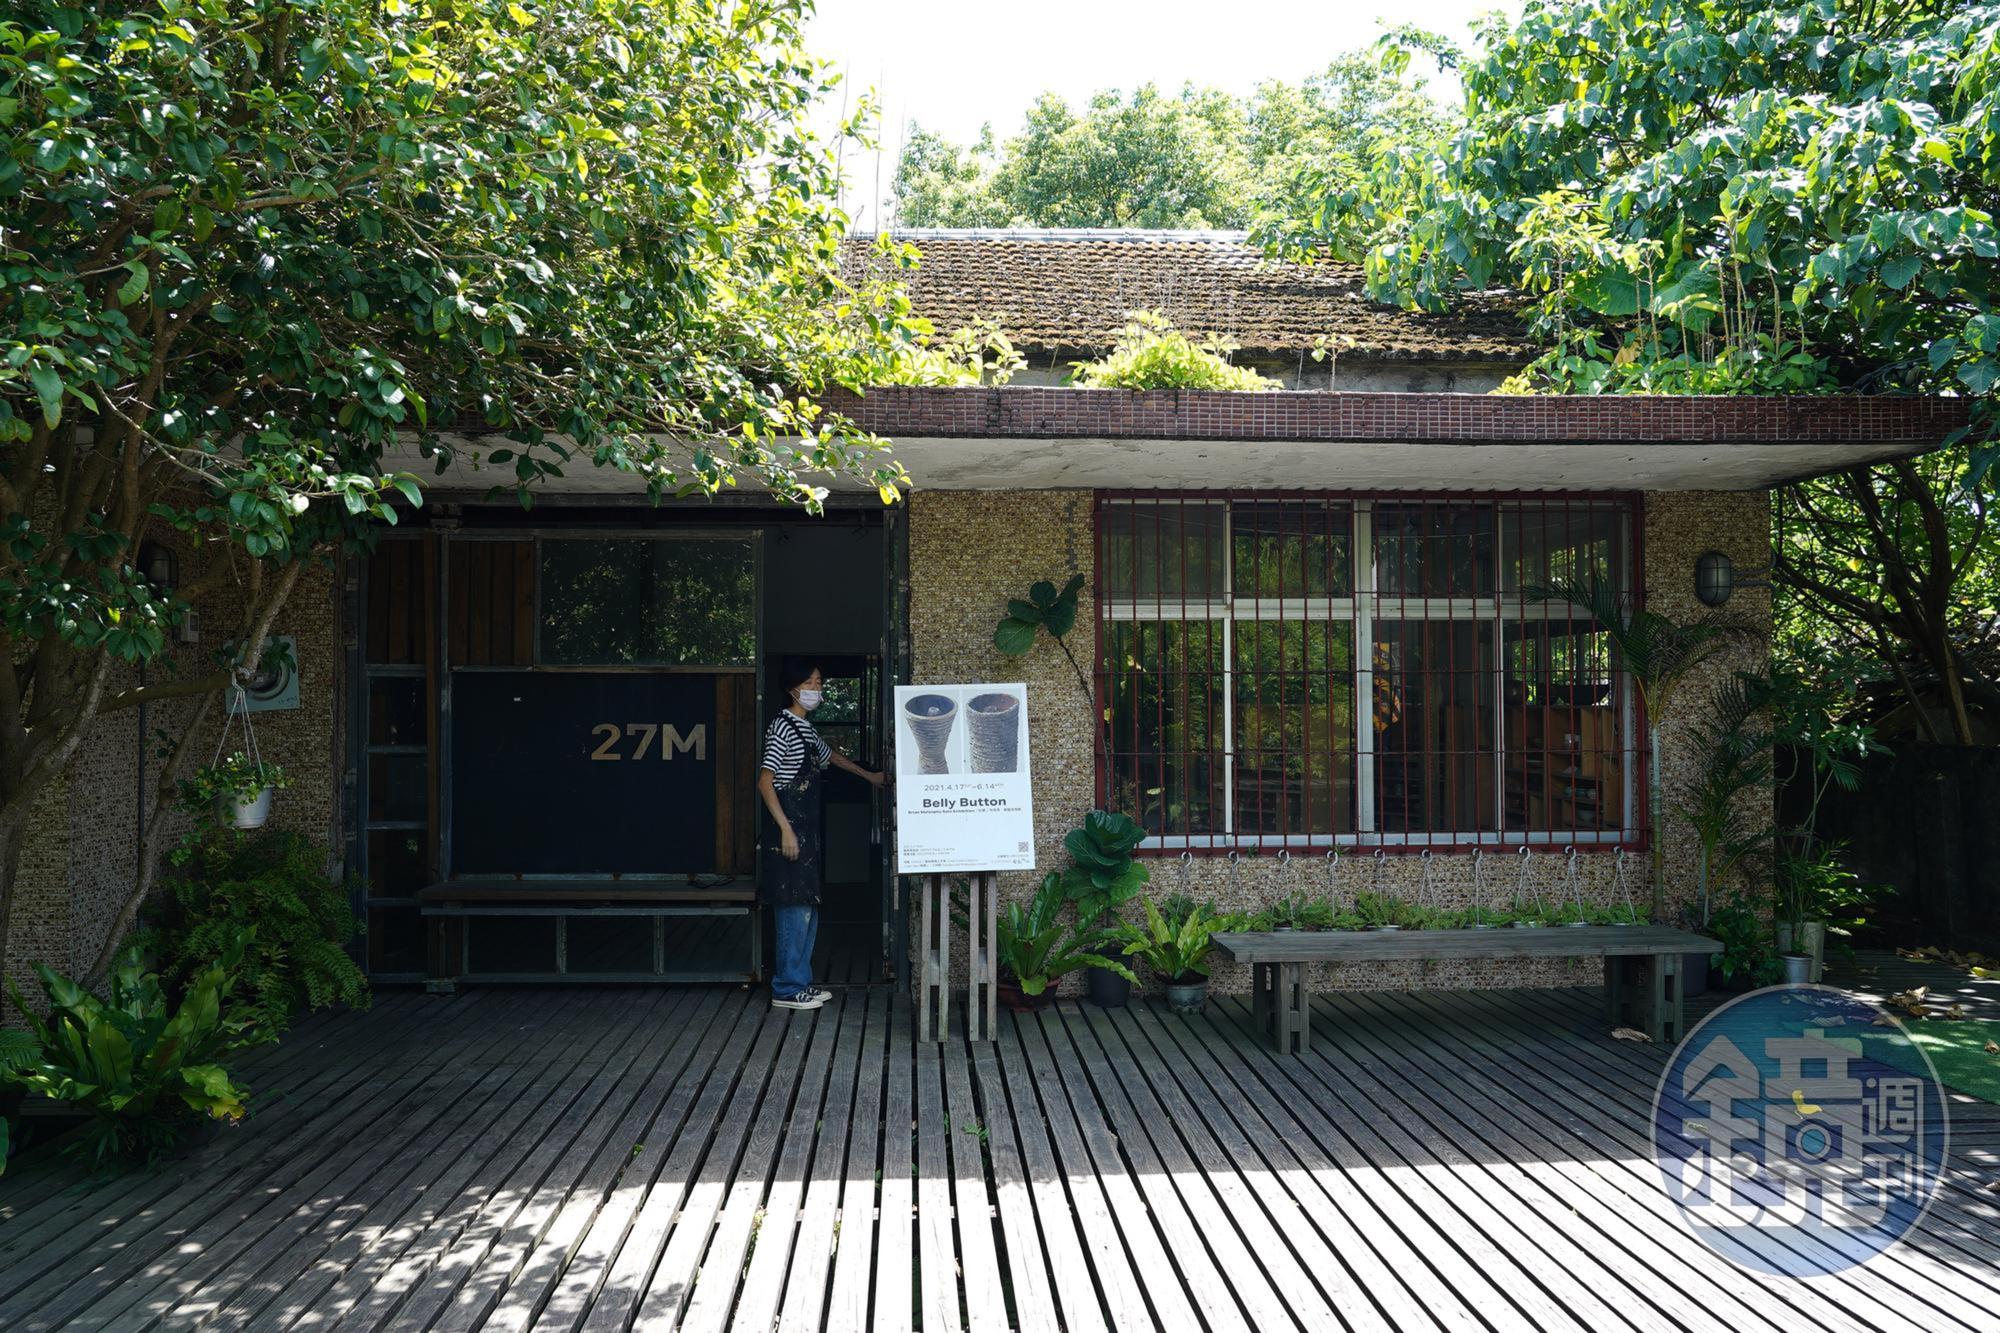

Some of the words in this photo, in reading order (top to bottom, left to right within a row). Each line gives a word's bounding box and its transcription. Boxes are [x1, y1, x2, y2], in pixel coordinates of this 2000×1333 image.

[591, 723, 706, 760] 27M
[922, 798, 956, 809] Belly
[960, 797, 1007, 807] Button
